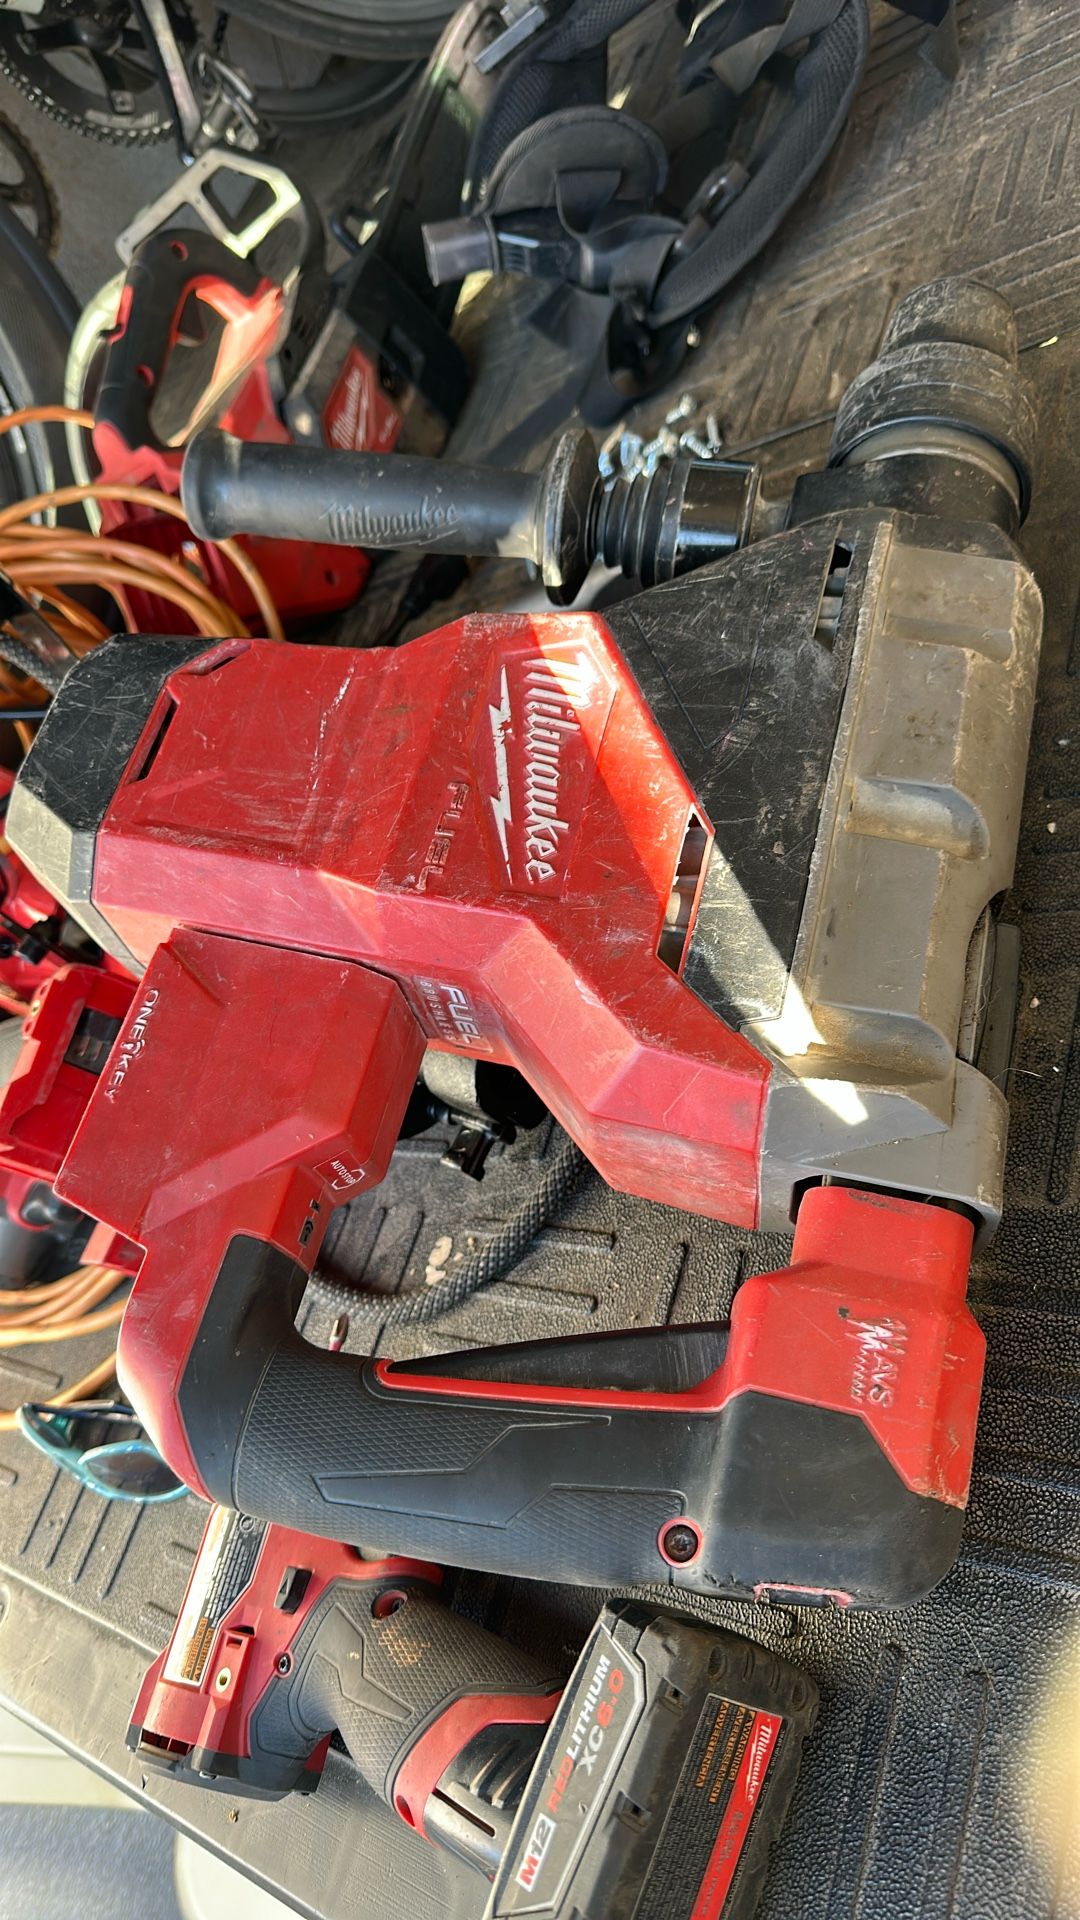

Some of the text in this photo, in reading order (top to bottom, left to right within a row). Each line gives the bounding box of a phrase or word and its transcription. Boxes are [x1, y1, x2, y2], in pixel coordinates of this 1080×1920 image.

[318, 495, 461, 542] Milwaukee
[522, 650, 600, 885] Milwaukee
[417, 782, 469, 891] FUEL
[420, 981, 456, 1040] BRUSHLESS
[440, 985, 481, 1044] FUEL
[330, 1160, 356, 1185] AUTOSTOP
[695, 1701, 729, 1788] ADVERTENCIA
[709, 1706, 746, 1803] AVERTISSEMENT
[729, 1718, 754, 1781] WARNING
[746, 1724, 772, 1801] Milwaukee
[519, 1820, 550, 1886] M12
